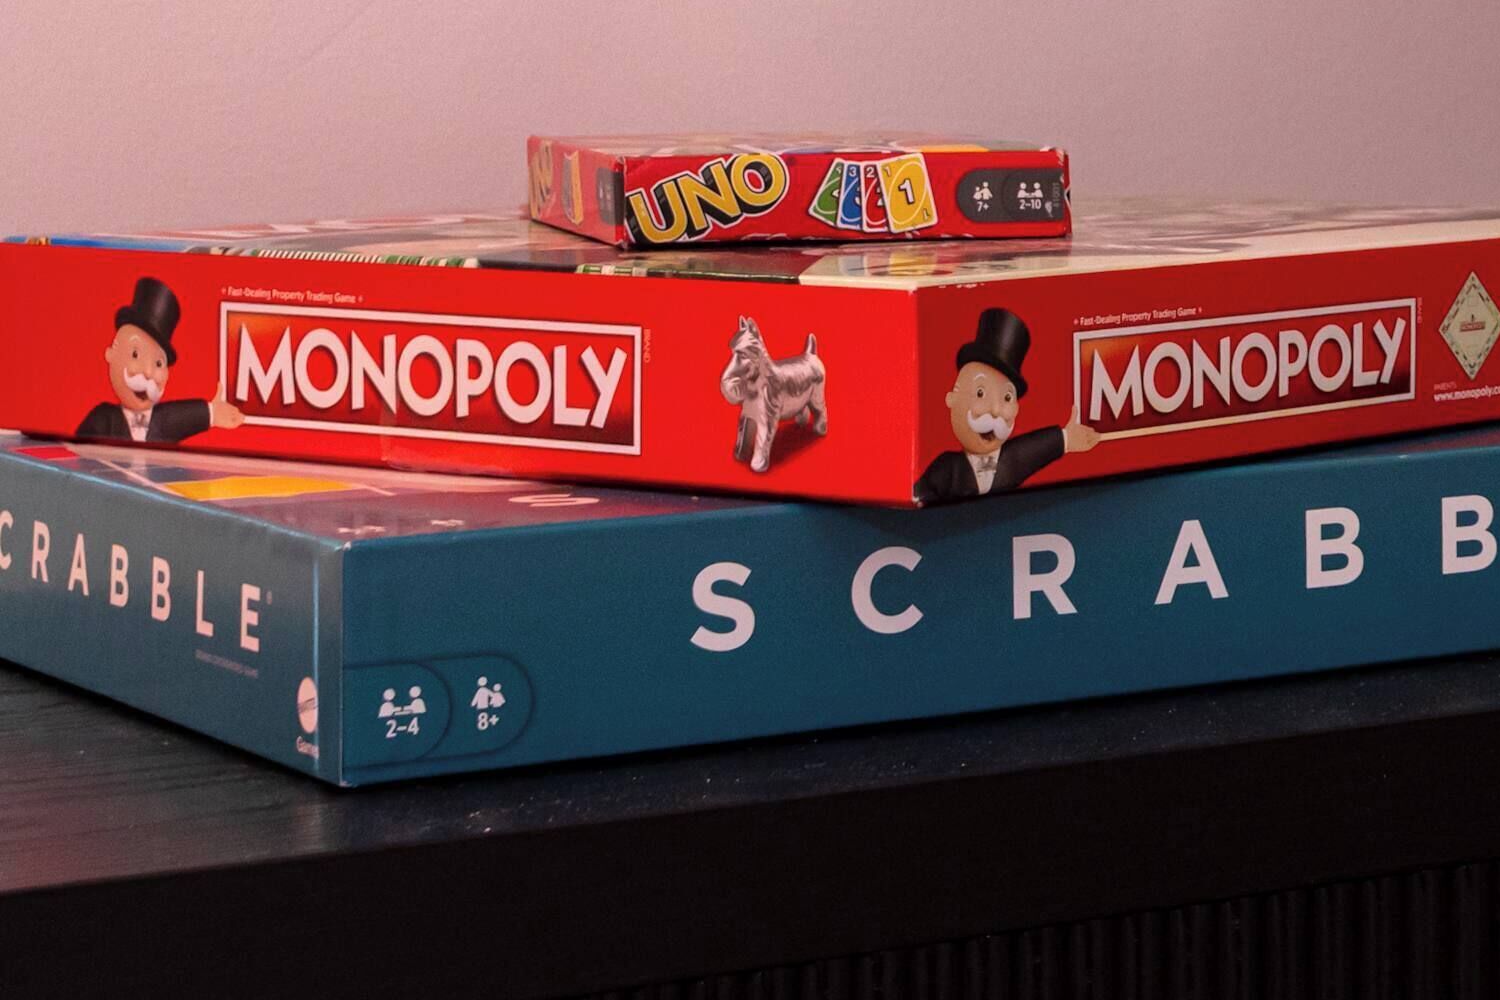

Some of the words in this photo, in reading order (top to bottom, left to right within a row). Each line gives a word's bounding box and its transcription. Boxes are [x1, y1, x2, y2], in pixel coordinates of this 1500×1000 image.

[625, 152, 787, 243] UNO
[898, 178, 915, 205] 1
[976, 201, 989, 212] 7+
[272, 289, 304, 302] Property
[306, 290, 333, 304] Trading
[334, 292, 356, 304] Game
[1121, 311, 1152, 322] Property
[1152, 308, 1177, 319] Trading
[1177, 306, 1197, 316] Game
[235, 322, 628, 429] MONOPOLY
[1089, 317, 1407, 421] MONOPOLY
[385, 717, 420, 739] 2-4
[477, 712, 500, 731] 8+
